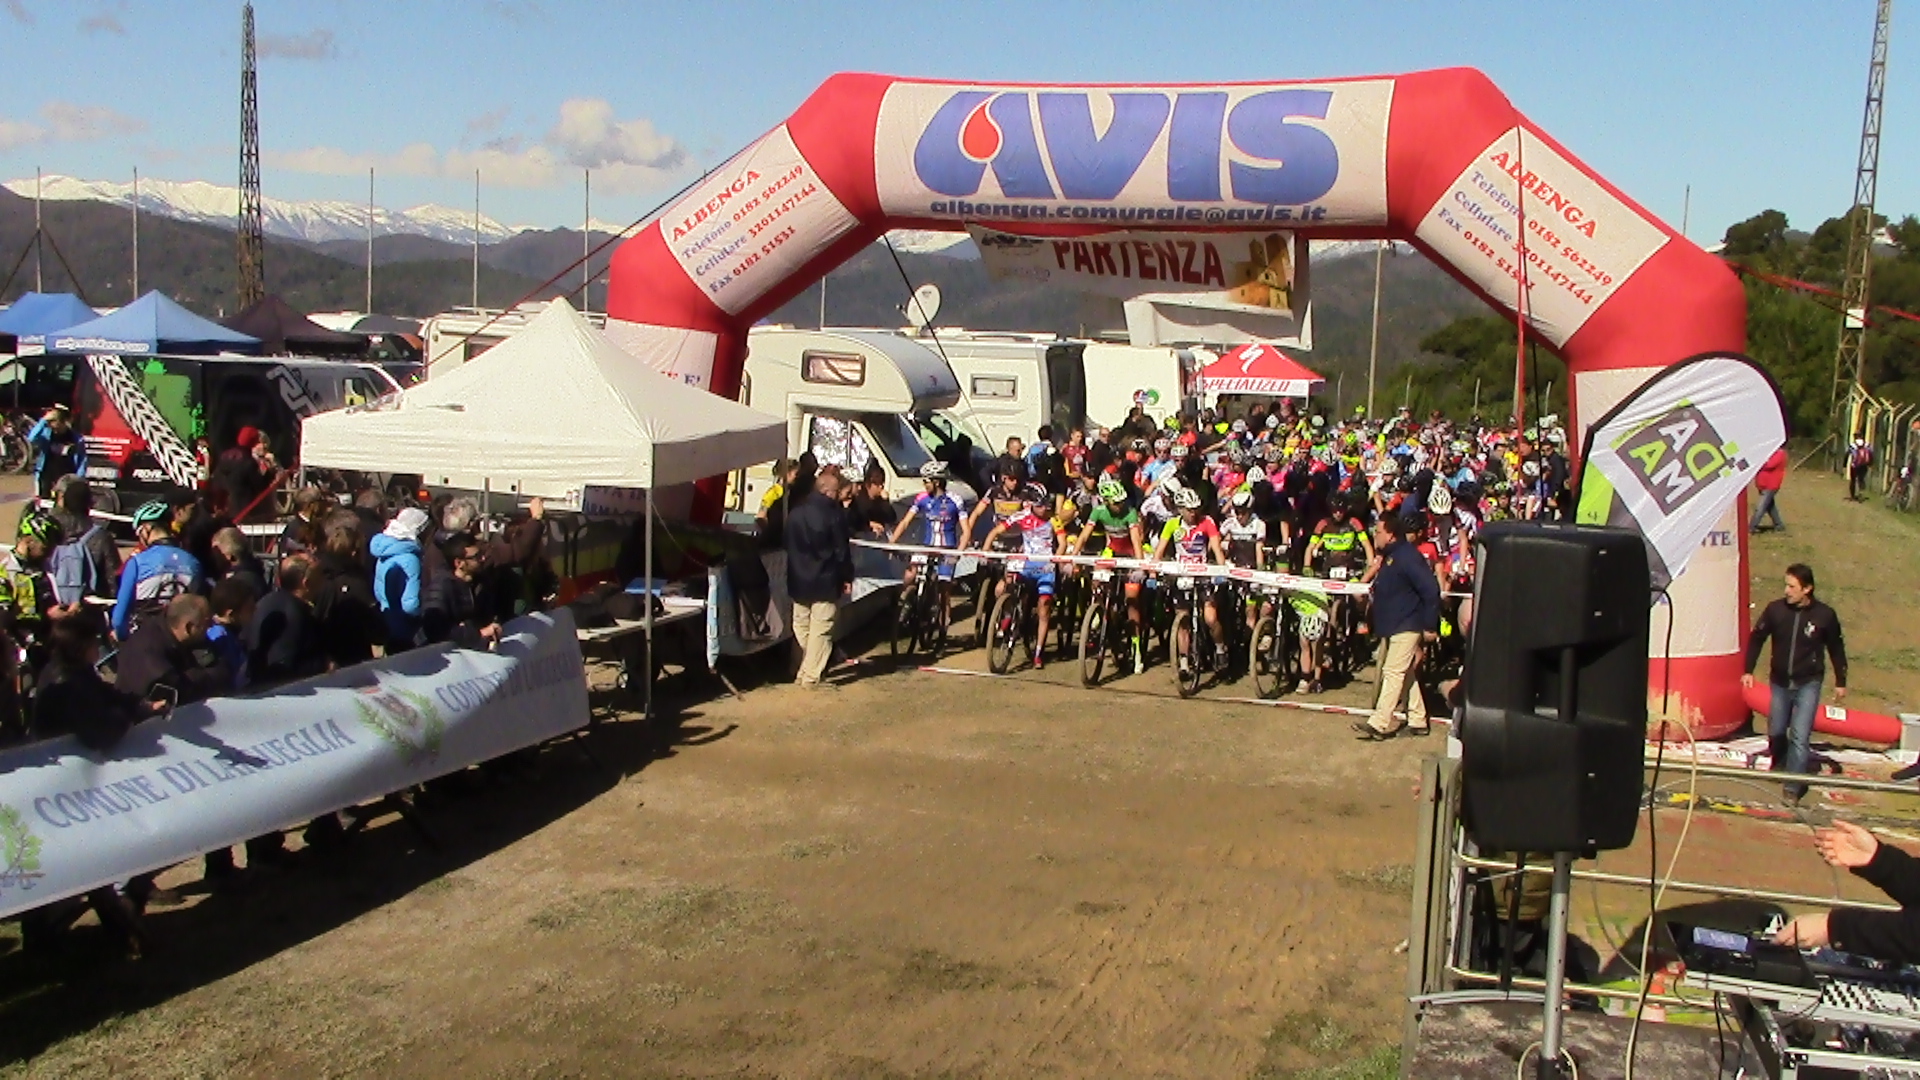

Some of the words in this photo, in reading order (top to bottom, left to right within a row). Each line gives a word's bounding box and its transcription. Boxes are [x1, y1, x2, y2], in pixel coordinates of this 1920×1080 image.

[914, 89, 1339, 205] AVIS
[672, 168, 761, 242] ALBENGA
[682, 220, 732, 260] Telefono
[732, 197, 761, 222] 0182
[762, 165, 803, 201] 562249
[695, 234, 748, 276] Cellulare
[748, 183, 817, 239] 3201147144
[931, 200, 1326, 223] albenga.comunale@avis.it
[1454, 191, 1513, 242] Cellulare
[1489, 151, 1597, 239] ALBENGA
[709, 274, 733, 293] Fax
[732, 252, 761, 276] 0182
[761, 225, 796, 256] 51531
[1053, 239, 1226, 288] PARTENZA
[1437, 207, 1463, 232] Fax
[1463, 230, 1496, 259] 0182
[1494, 257, 1536, 291] 5151
[1528, 219, 1562, 248] 0182
[1560, 246, 1613, 287] 562249
[34, 774, 170, 828] COMUNE
[157, 761, 211, 794] DI
